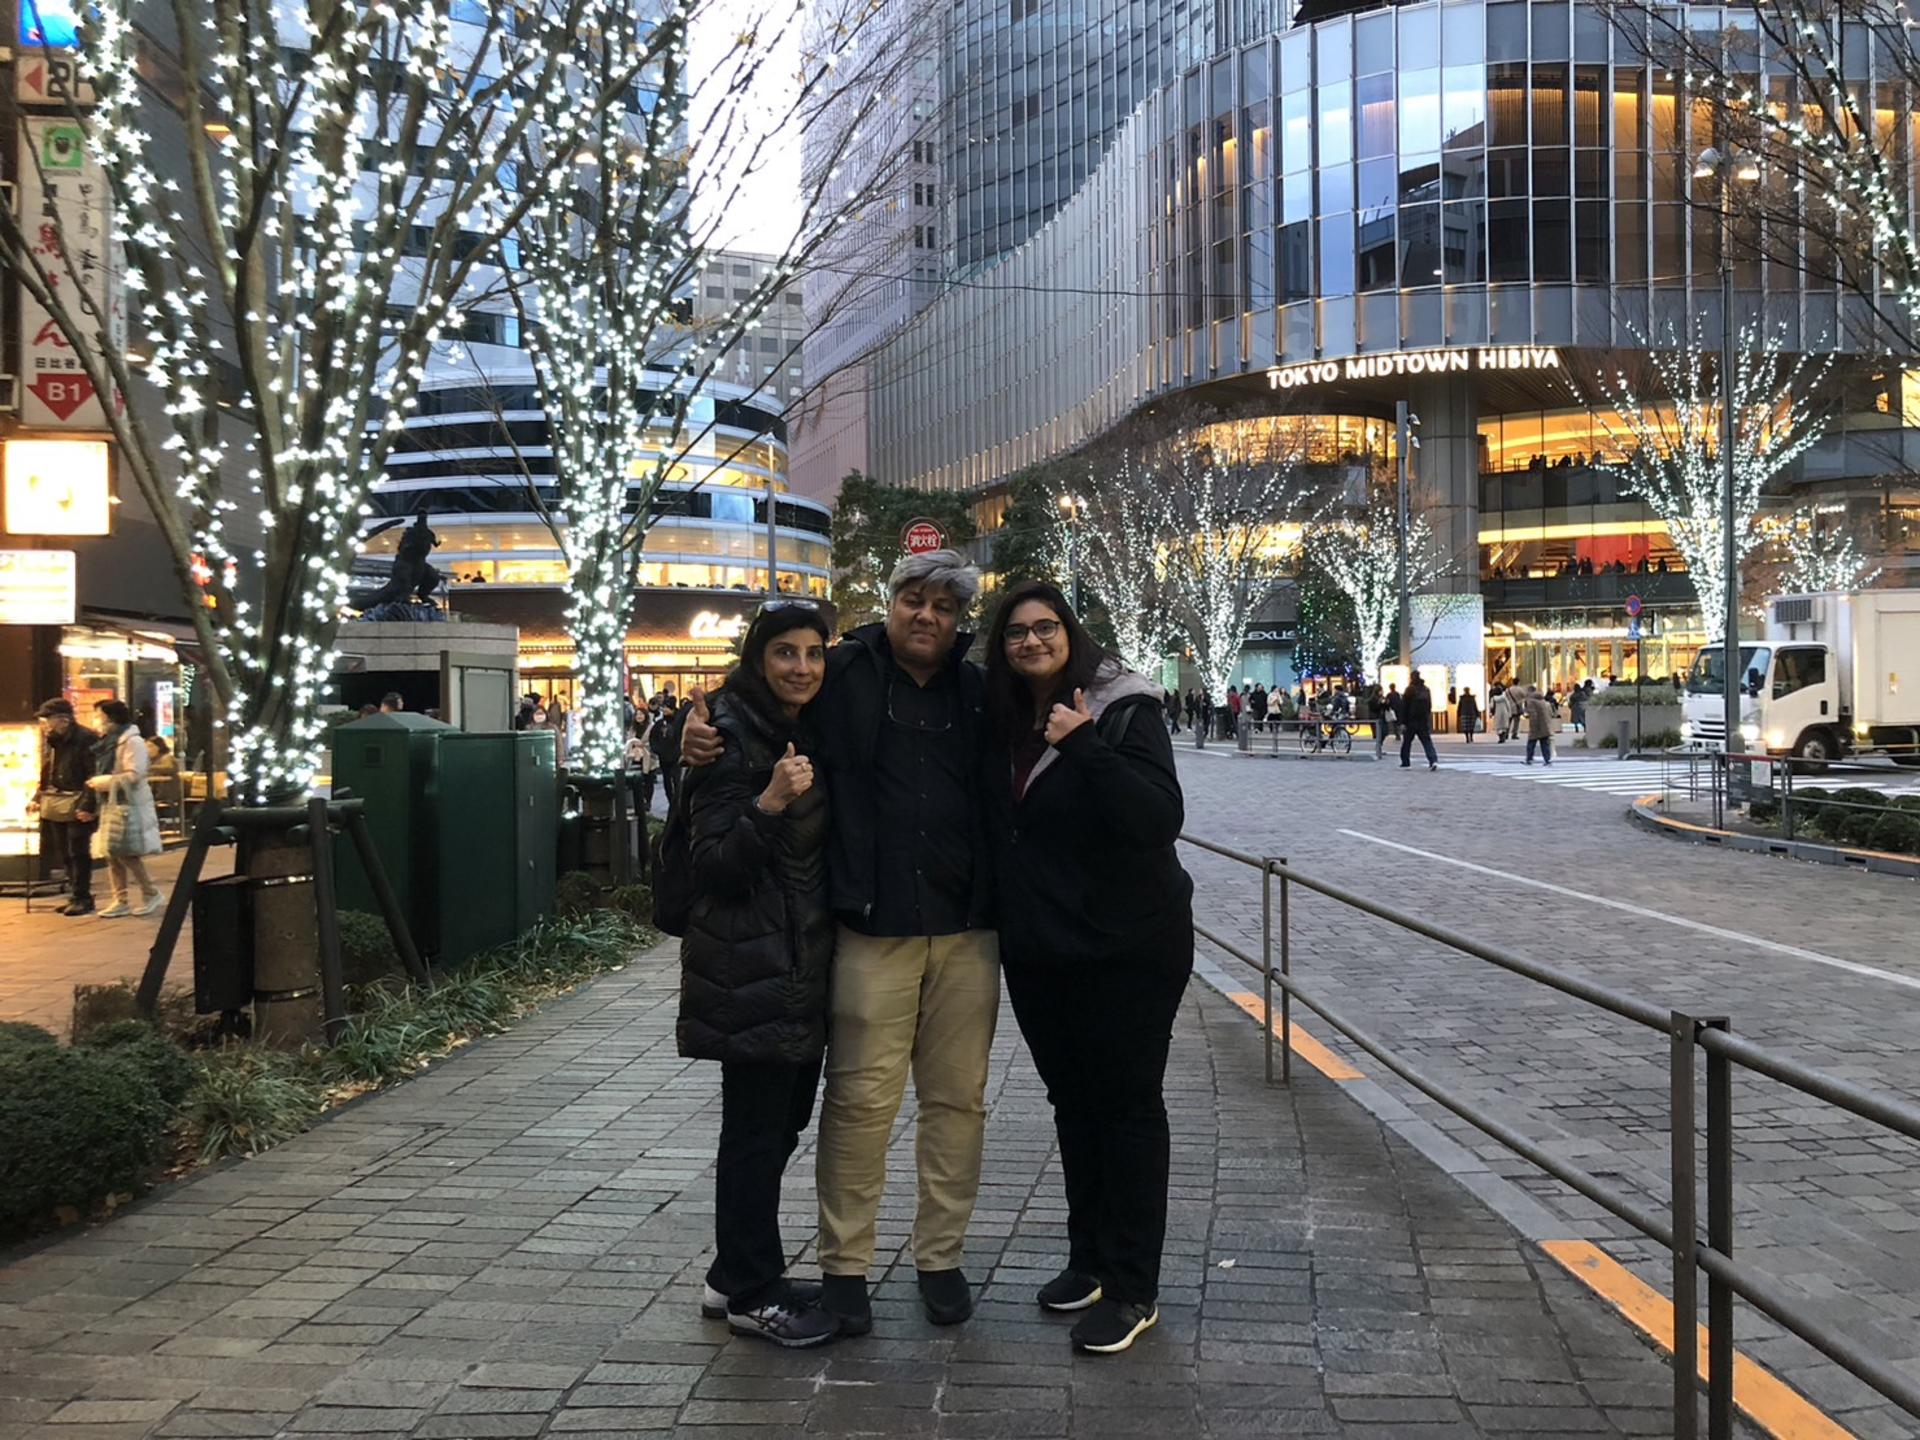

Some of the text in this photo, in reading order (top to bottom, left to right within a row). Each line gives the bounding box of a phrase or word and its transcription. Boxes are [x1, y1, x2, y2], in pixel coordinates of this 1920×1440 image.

[35, 357, 84, 369] 日比谷
[1266, 349, 1559, 390] TOKYO MIDTOWN HIBIYA
[47, 382, 80, 402] B1
